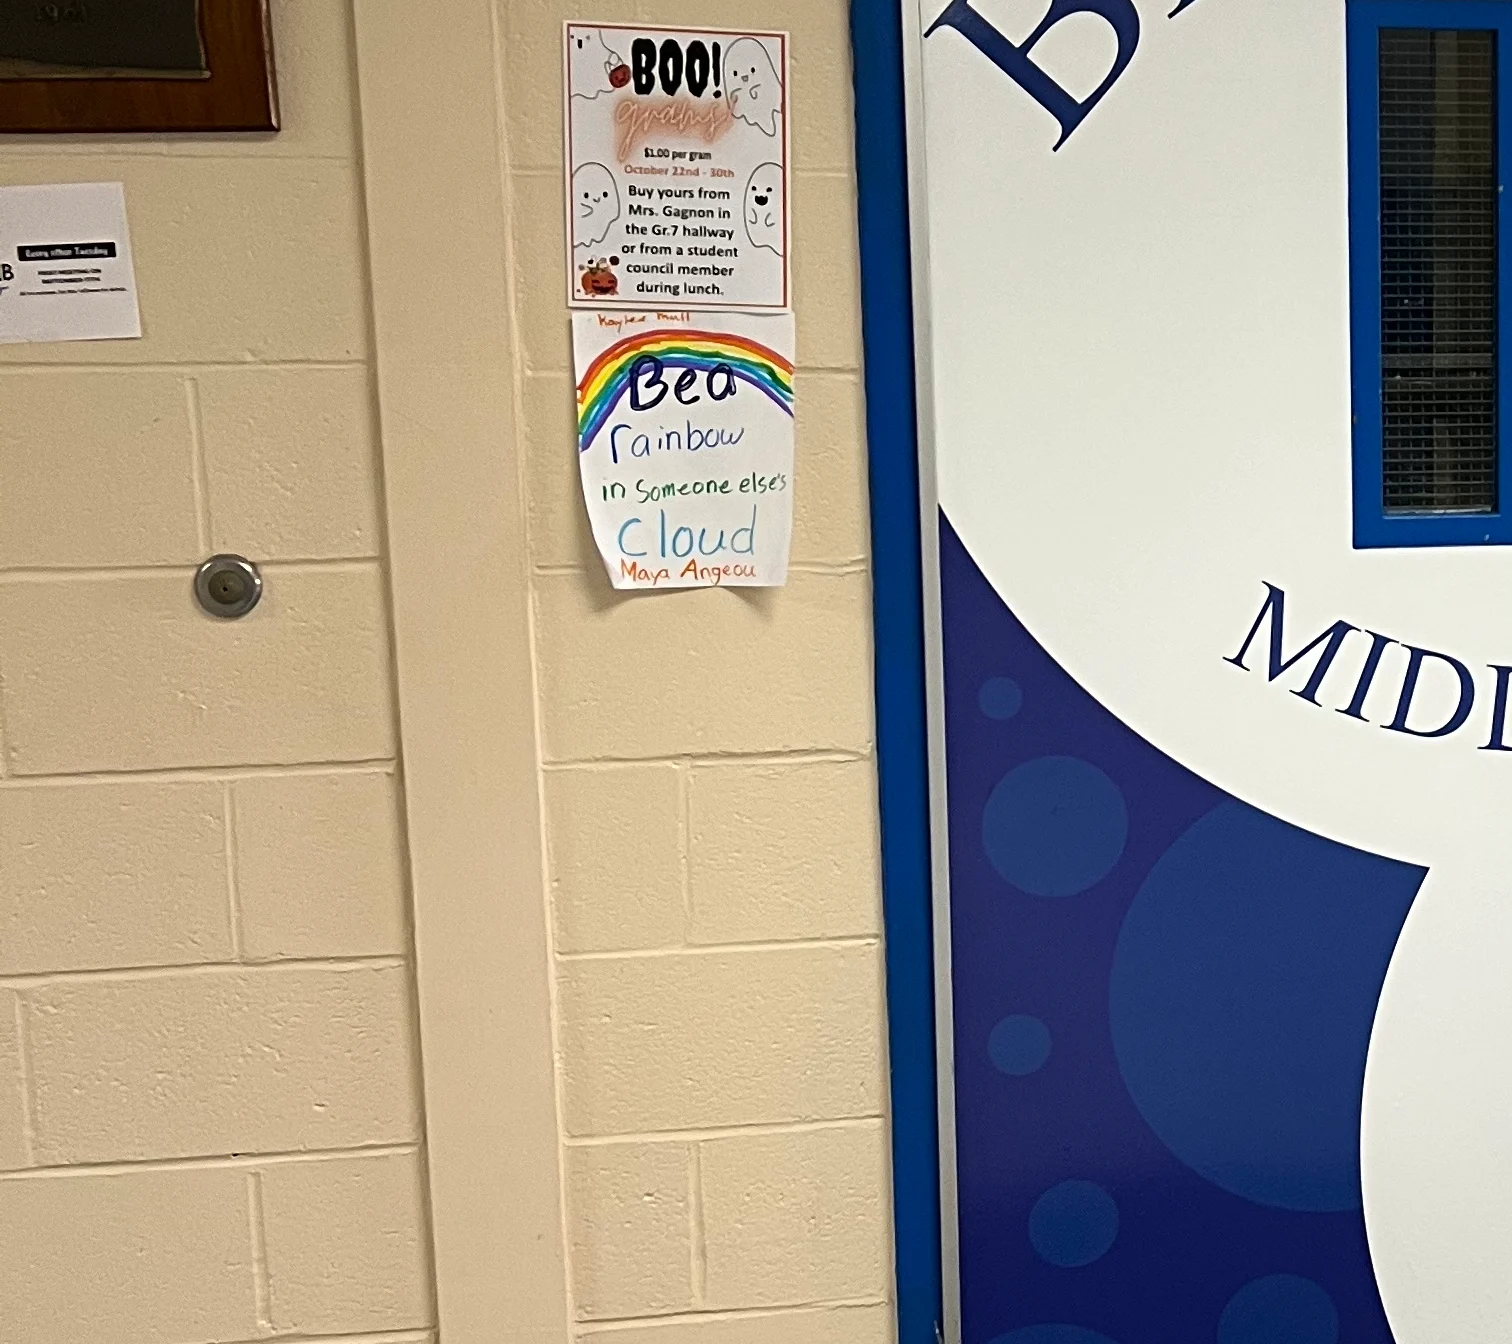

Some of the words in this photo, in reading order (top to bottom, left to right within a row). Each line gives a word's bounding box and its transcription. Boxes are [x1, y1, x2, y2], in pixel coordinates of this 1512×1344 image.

[631, 37, 722, 99] BOO!
[644, 146, 670, 158] $1.00
[672, 151, 687, 161] per
[689, 151, 712, 161] gram
[624, 164, 669, 175] October
[672, 166, 700, 177] 22nd
[710, 167, 735, 178] 30th
[628, 184, 654, 200] Buy
[657, 188, 694, 200] yours
[698, 186, 730, 199] from
[628, 204, 659, 216] Mrs.
[662, 205, 714, 220] Gagnon
[718, 207, 731, 219] in
[625, 223, 648, 235] the
[651, 224, 679, 237] Gr.7
[682, 224, 734, 240] hallway
[621, 244, 636, 253] or
[640, 242, 672, 255] from
[676, 246, 684, 256] a
[687, 245, 739, 257] student
[626, 262, 674, 274] council
[677, 264, 735, 276] member
[636, 280, 680, 296] during
[683, 282, 725, 296] lunch.
[610, 420, 745, 464] rainbow
[602, 476, 626, 502] in
[620, 559, 671, 585] Maya
